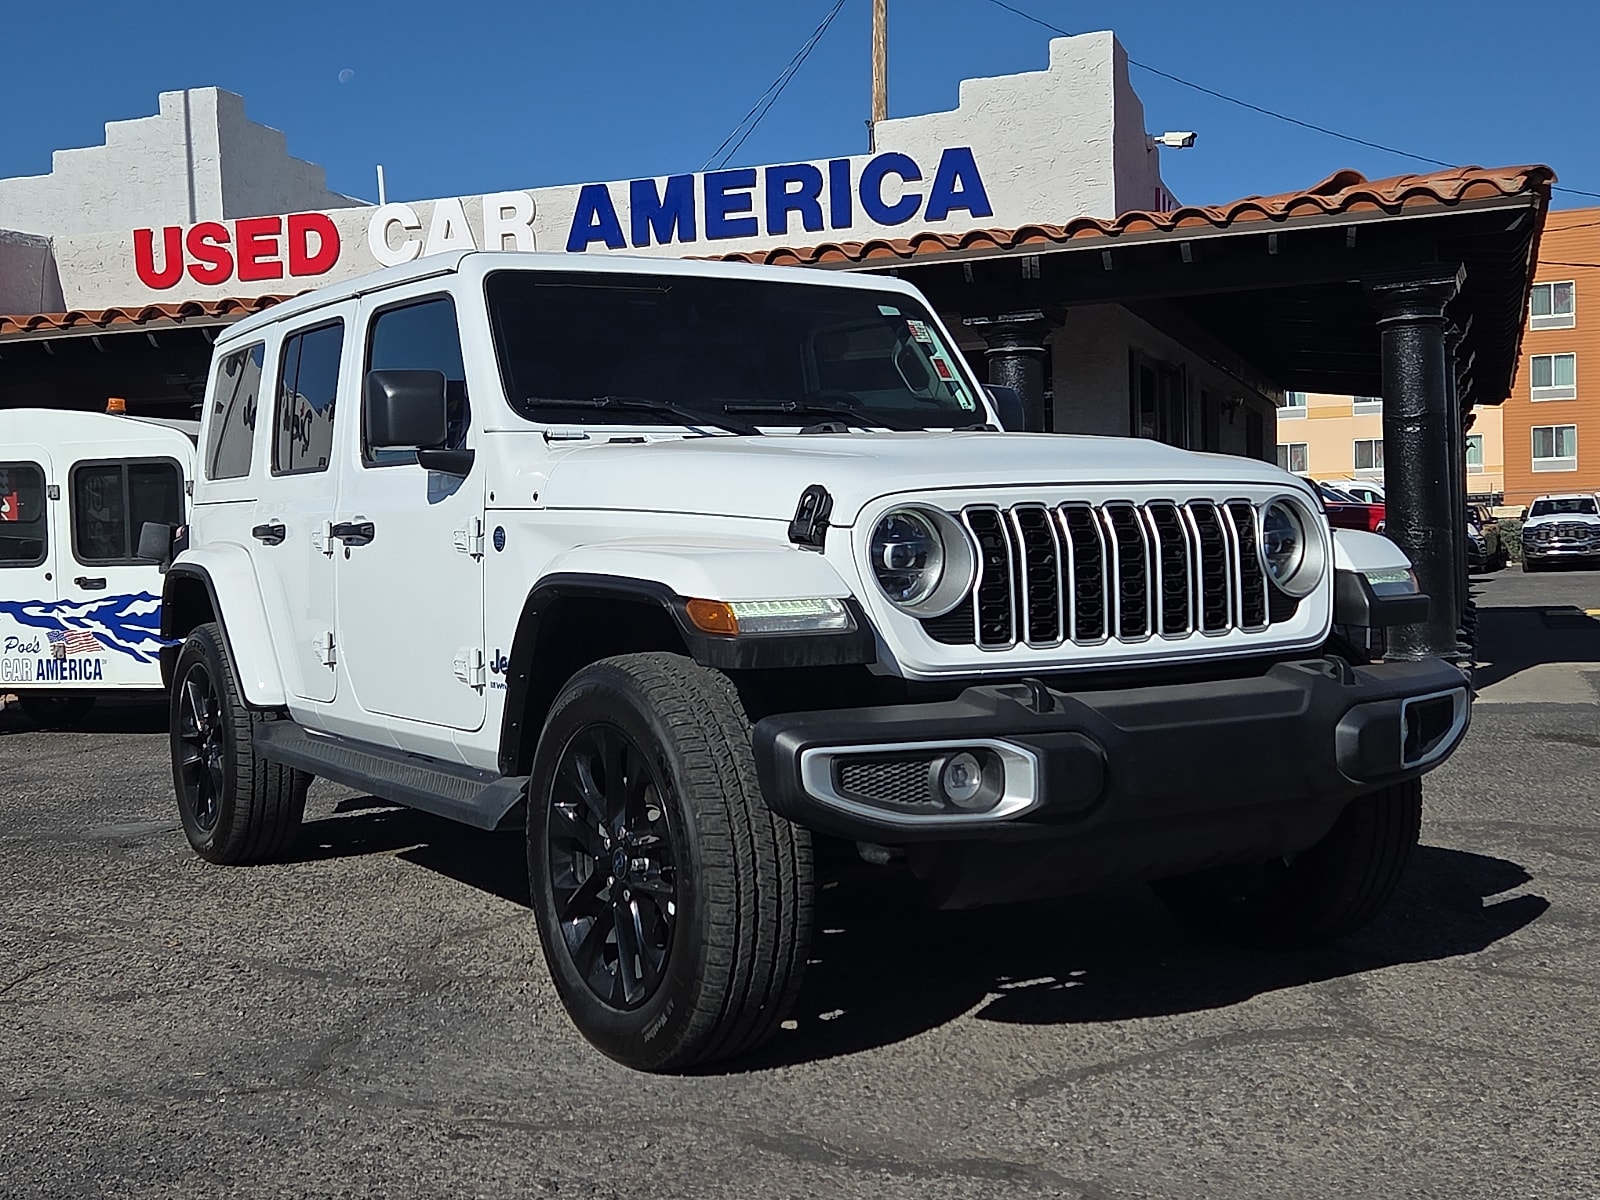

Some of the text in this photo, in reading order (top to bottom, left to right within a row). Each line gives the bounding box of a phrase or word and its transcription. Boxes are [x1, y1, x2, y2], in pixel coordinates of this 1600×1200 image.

[133, 146, 994, 290] USED CAR AMERICA
[4, 635, 42, 654] Poe's
[1, 658, 103, 681] CAR AMERICA
